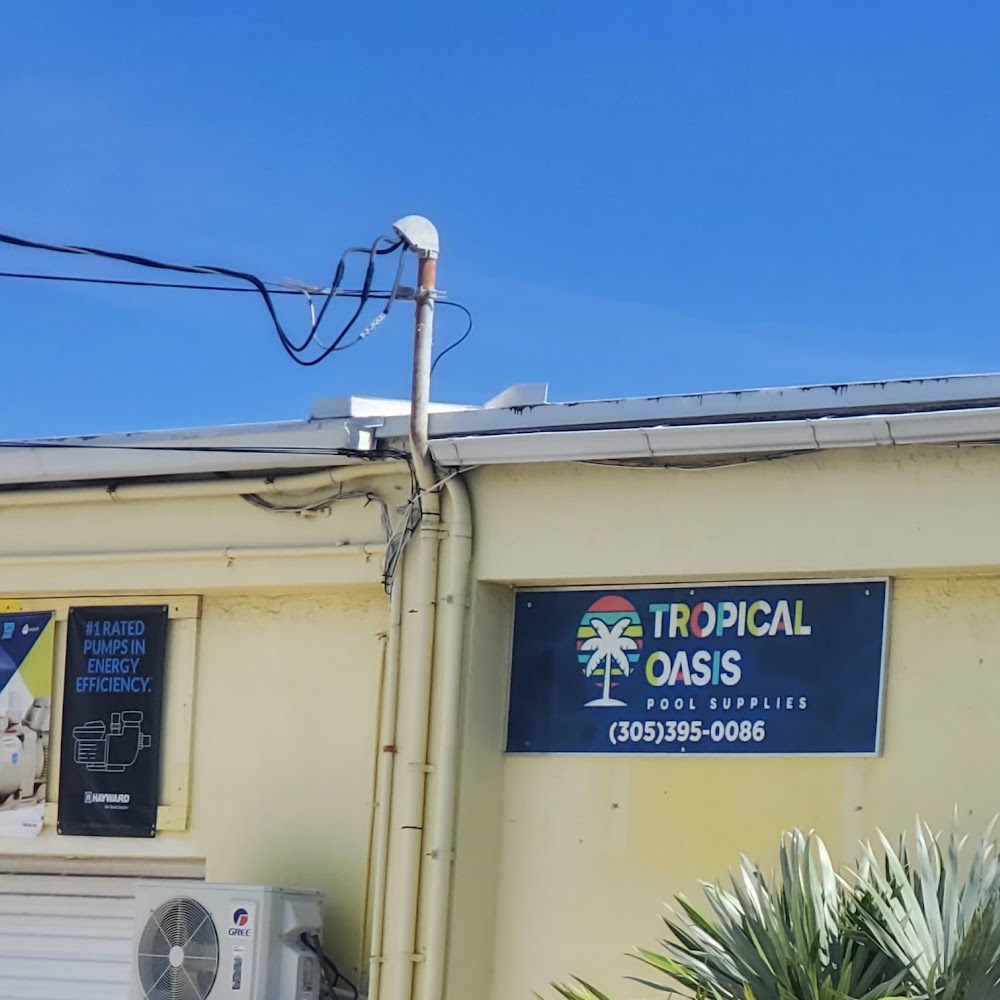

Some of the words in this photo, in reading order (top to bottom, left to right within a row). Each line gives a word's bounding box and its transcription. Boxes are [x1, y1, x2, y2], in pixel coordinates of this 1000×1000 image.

[649, 600, 812, 638] TROPICAL
[86, 620, 100, 636] #1
[103, 620, 145, 635] RATED
[84, 639, 128, 655] PUMPS
[131, 639, 146, 654] IN
[88, 658, 140, 673] ENERGY
[645, 650, 742, 686] OASIS
[76, 677, 151, 692] EFFICIENCY.
[647, 698, 696, 710] POOL
[710, 697, 809, 710] SUPPLIES
[609, 720, 765, 744] (305)395-0086
[92, 793, 130, 803] HAYWARD
[228, 928, 252, 936] GREE
